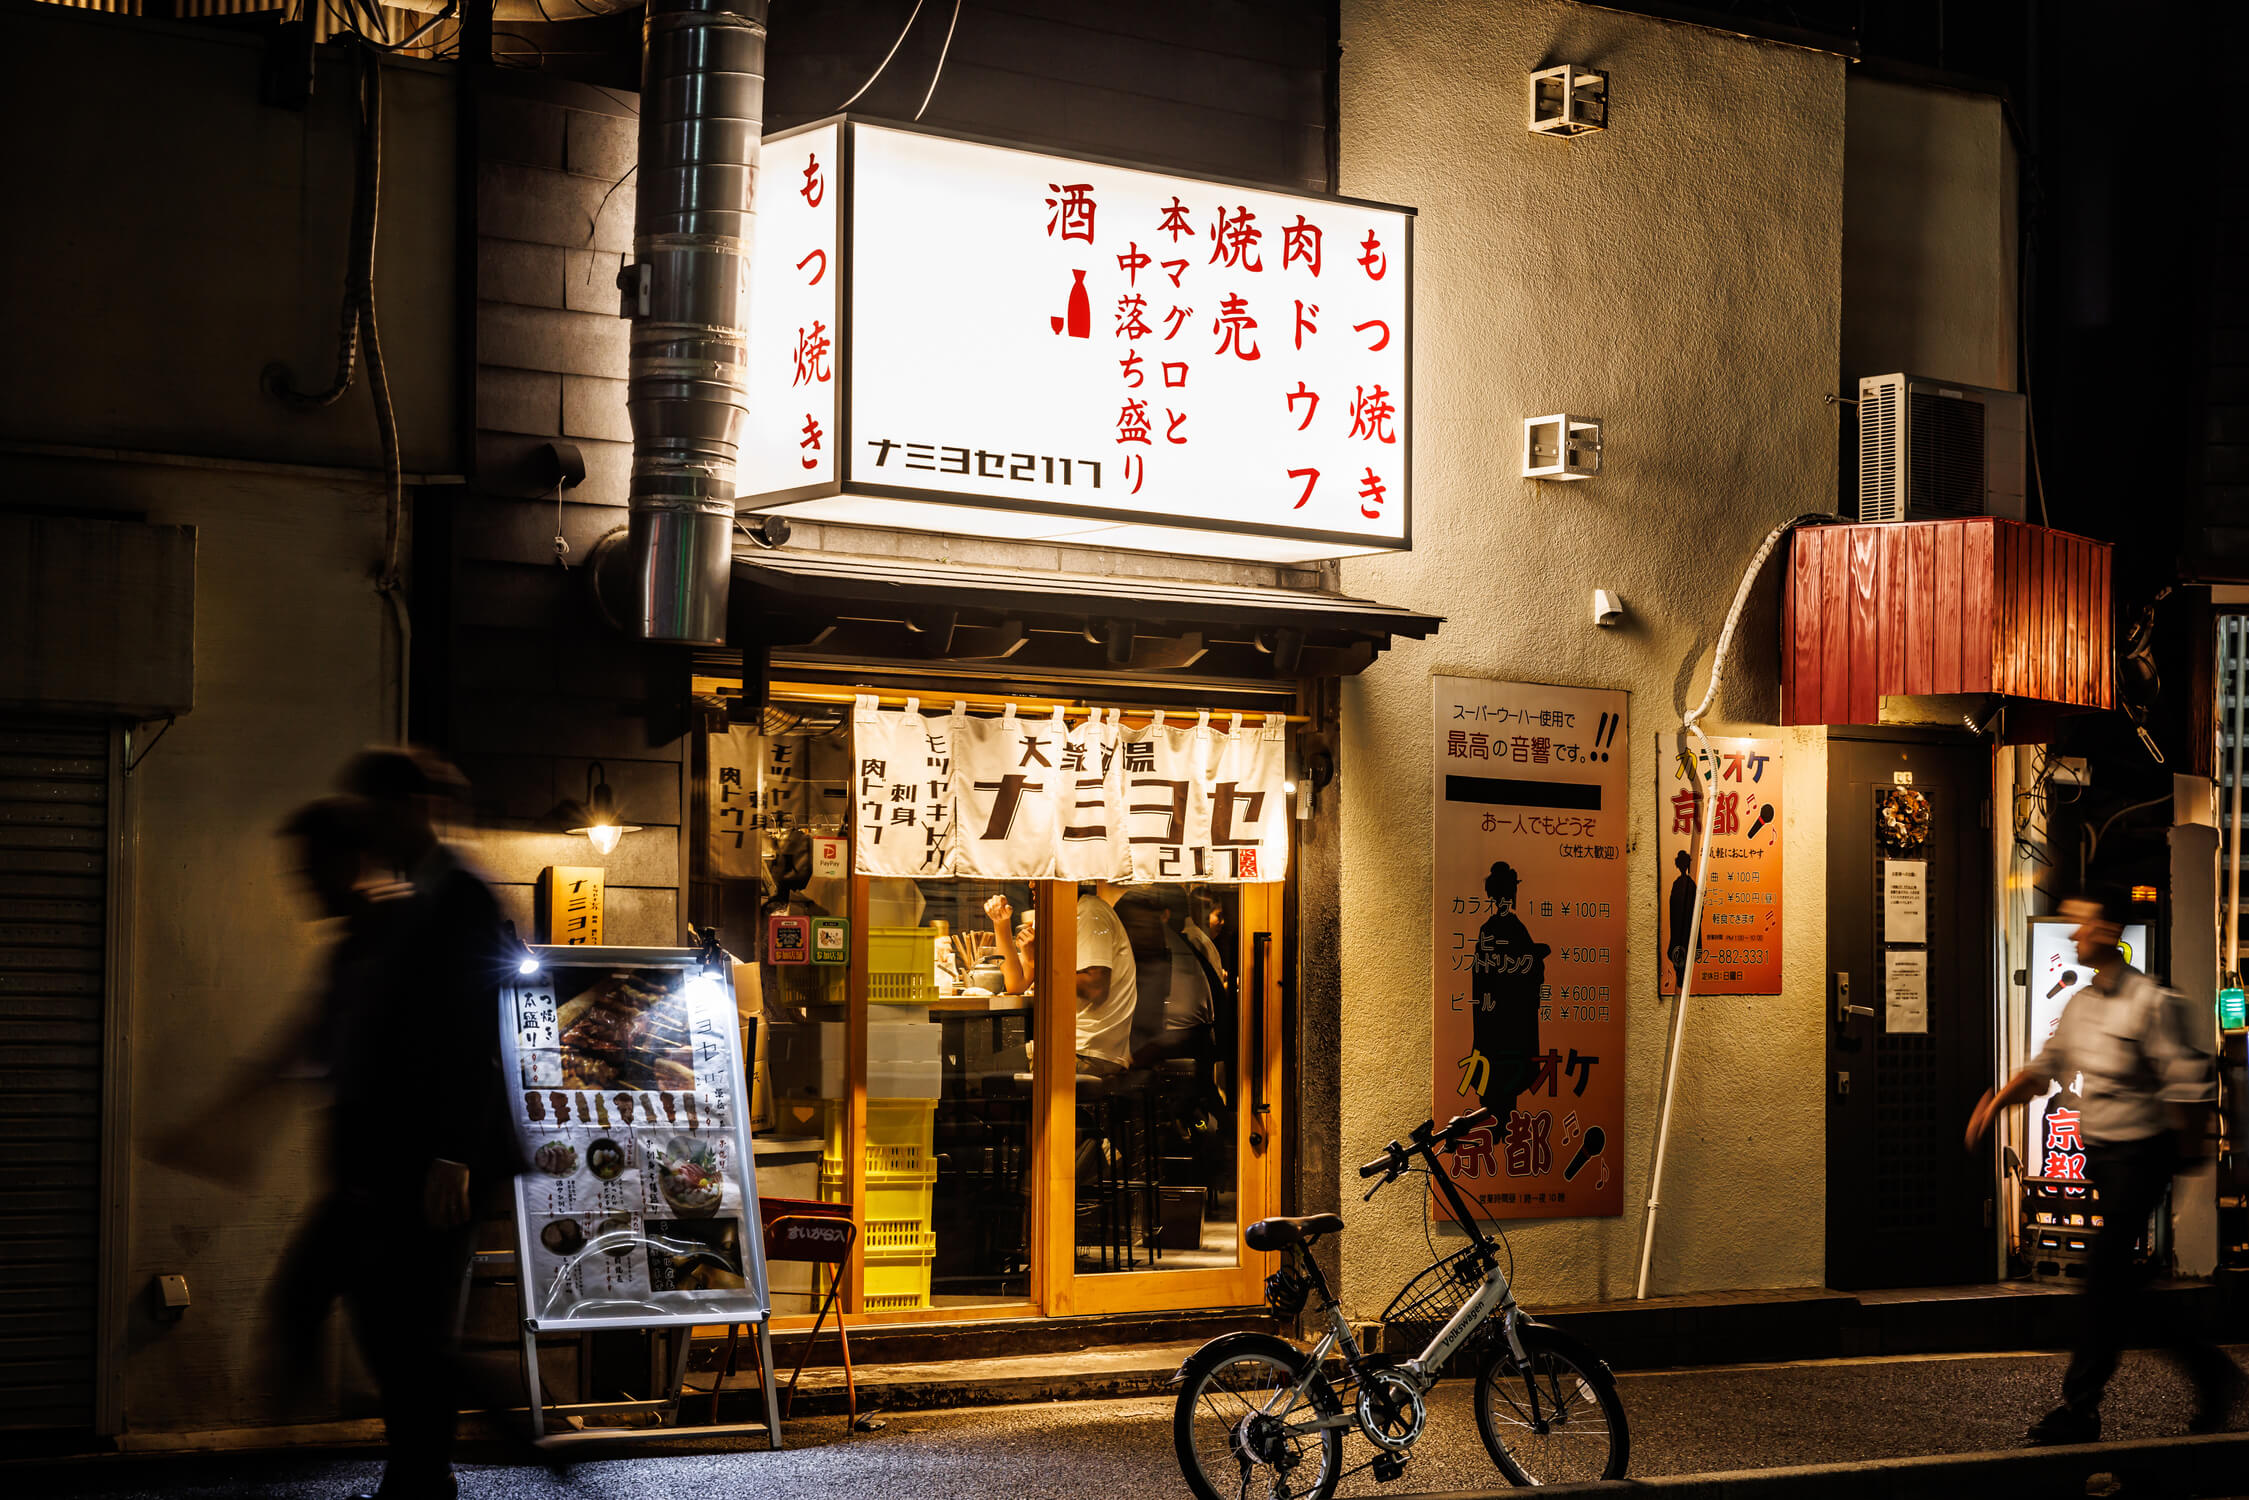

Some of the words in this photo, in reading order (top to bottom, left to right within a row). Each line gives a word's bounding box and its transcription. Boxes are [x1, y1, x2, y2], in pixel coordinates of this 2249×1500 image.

[1046, 183, 1096, 244] 酒
[793, 153, 831, 470] もつ焼き
[1210, 205, 1263, 362] 焼売
[1157, 196, 1195, 446] 本マグロと
[1115, 243, 1153, 495] 中落ち盛り
[1282, 215, 1323, 511] 肉ドウフ
[1349, 229, 1396, 520] もつ焼き
[891, 784, 917, 826] 刺身
[974, 774, 1265, 846] ナミヨセ
[1481, 811, 1597, 837] お一人でもどうぞ
[1452, 896, 1513, 917] カラオケ
[1451, 953, 1534, 974] ソフトドリンク
[1452, 932, 1510, 951] コーヒー
[1451, 992, 1497, 1012] ビール
[1441, 1301, 1485, 1348] Volkswagen
